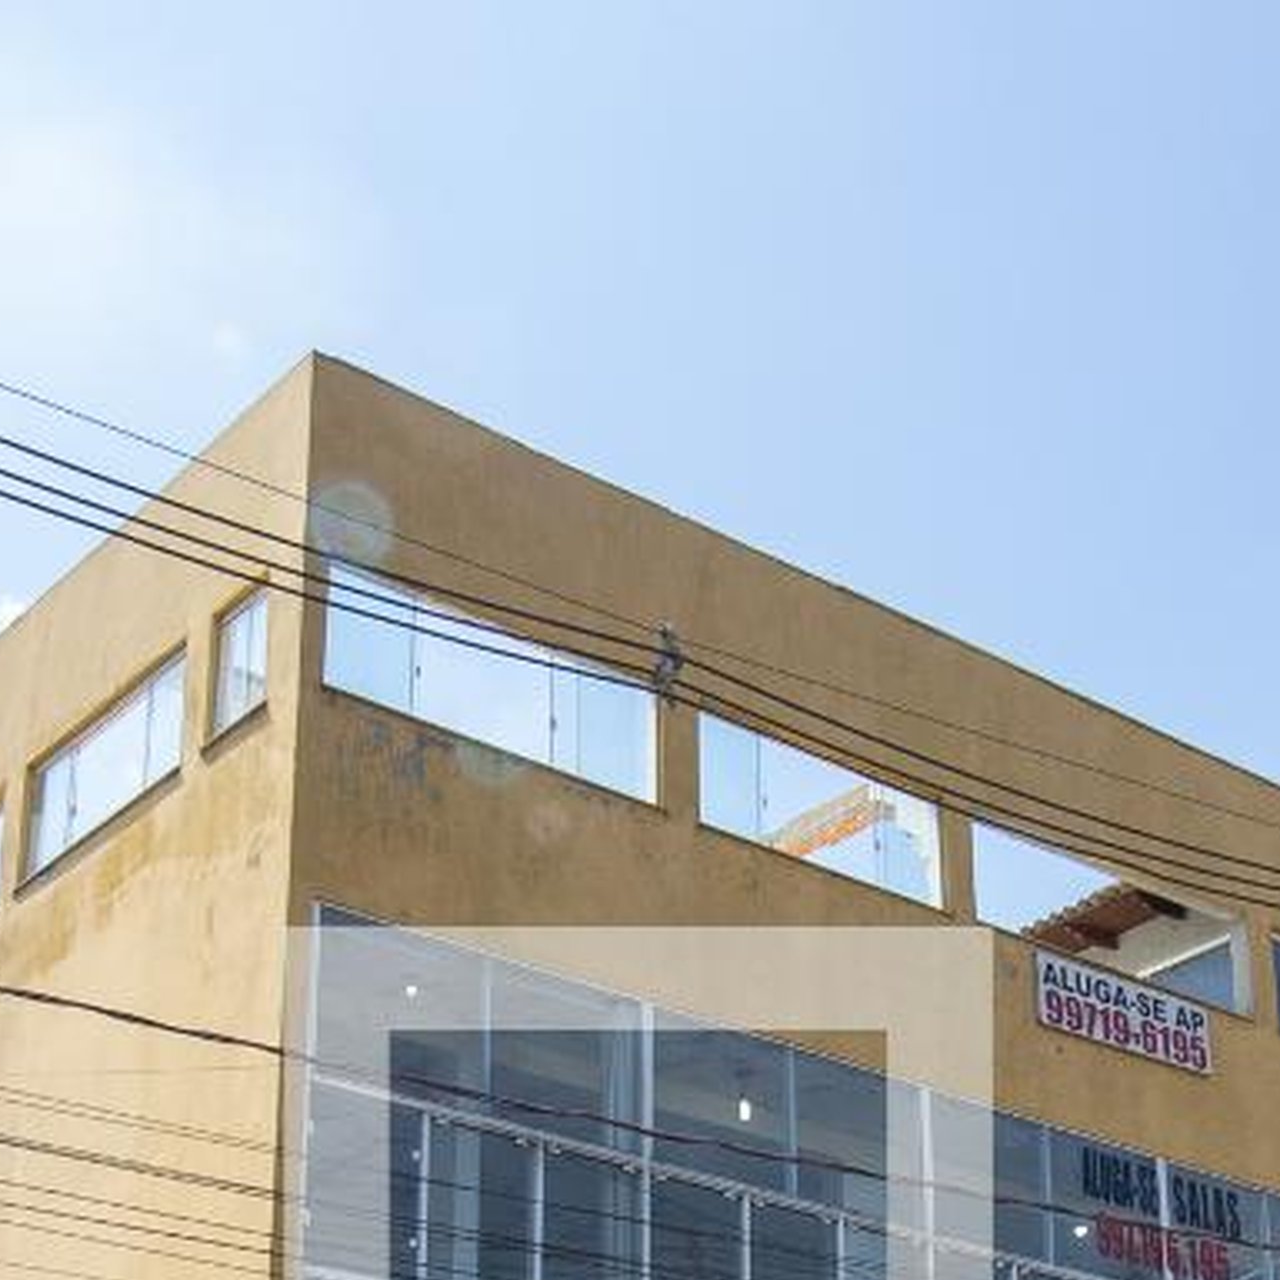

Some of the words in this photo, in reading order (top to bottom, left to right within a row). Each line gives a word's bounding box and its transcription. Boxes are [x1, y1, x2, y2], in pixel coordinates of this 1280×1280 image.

[1043, 963, 1167, 1025] ALUGA-SE
[1175, 1004, 1205, 1034] AP
[1045, 988, 1208, 1069] 99719-6195
[1172, 1173, 1242, 1238] SALAS
